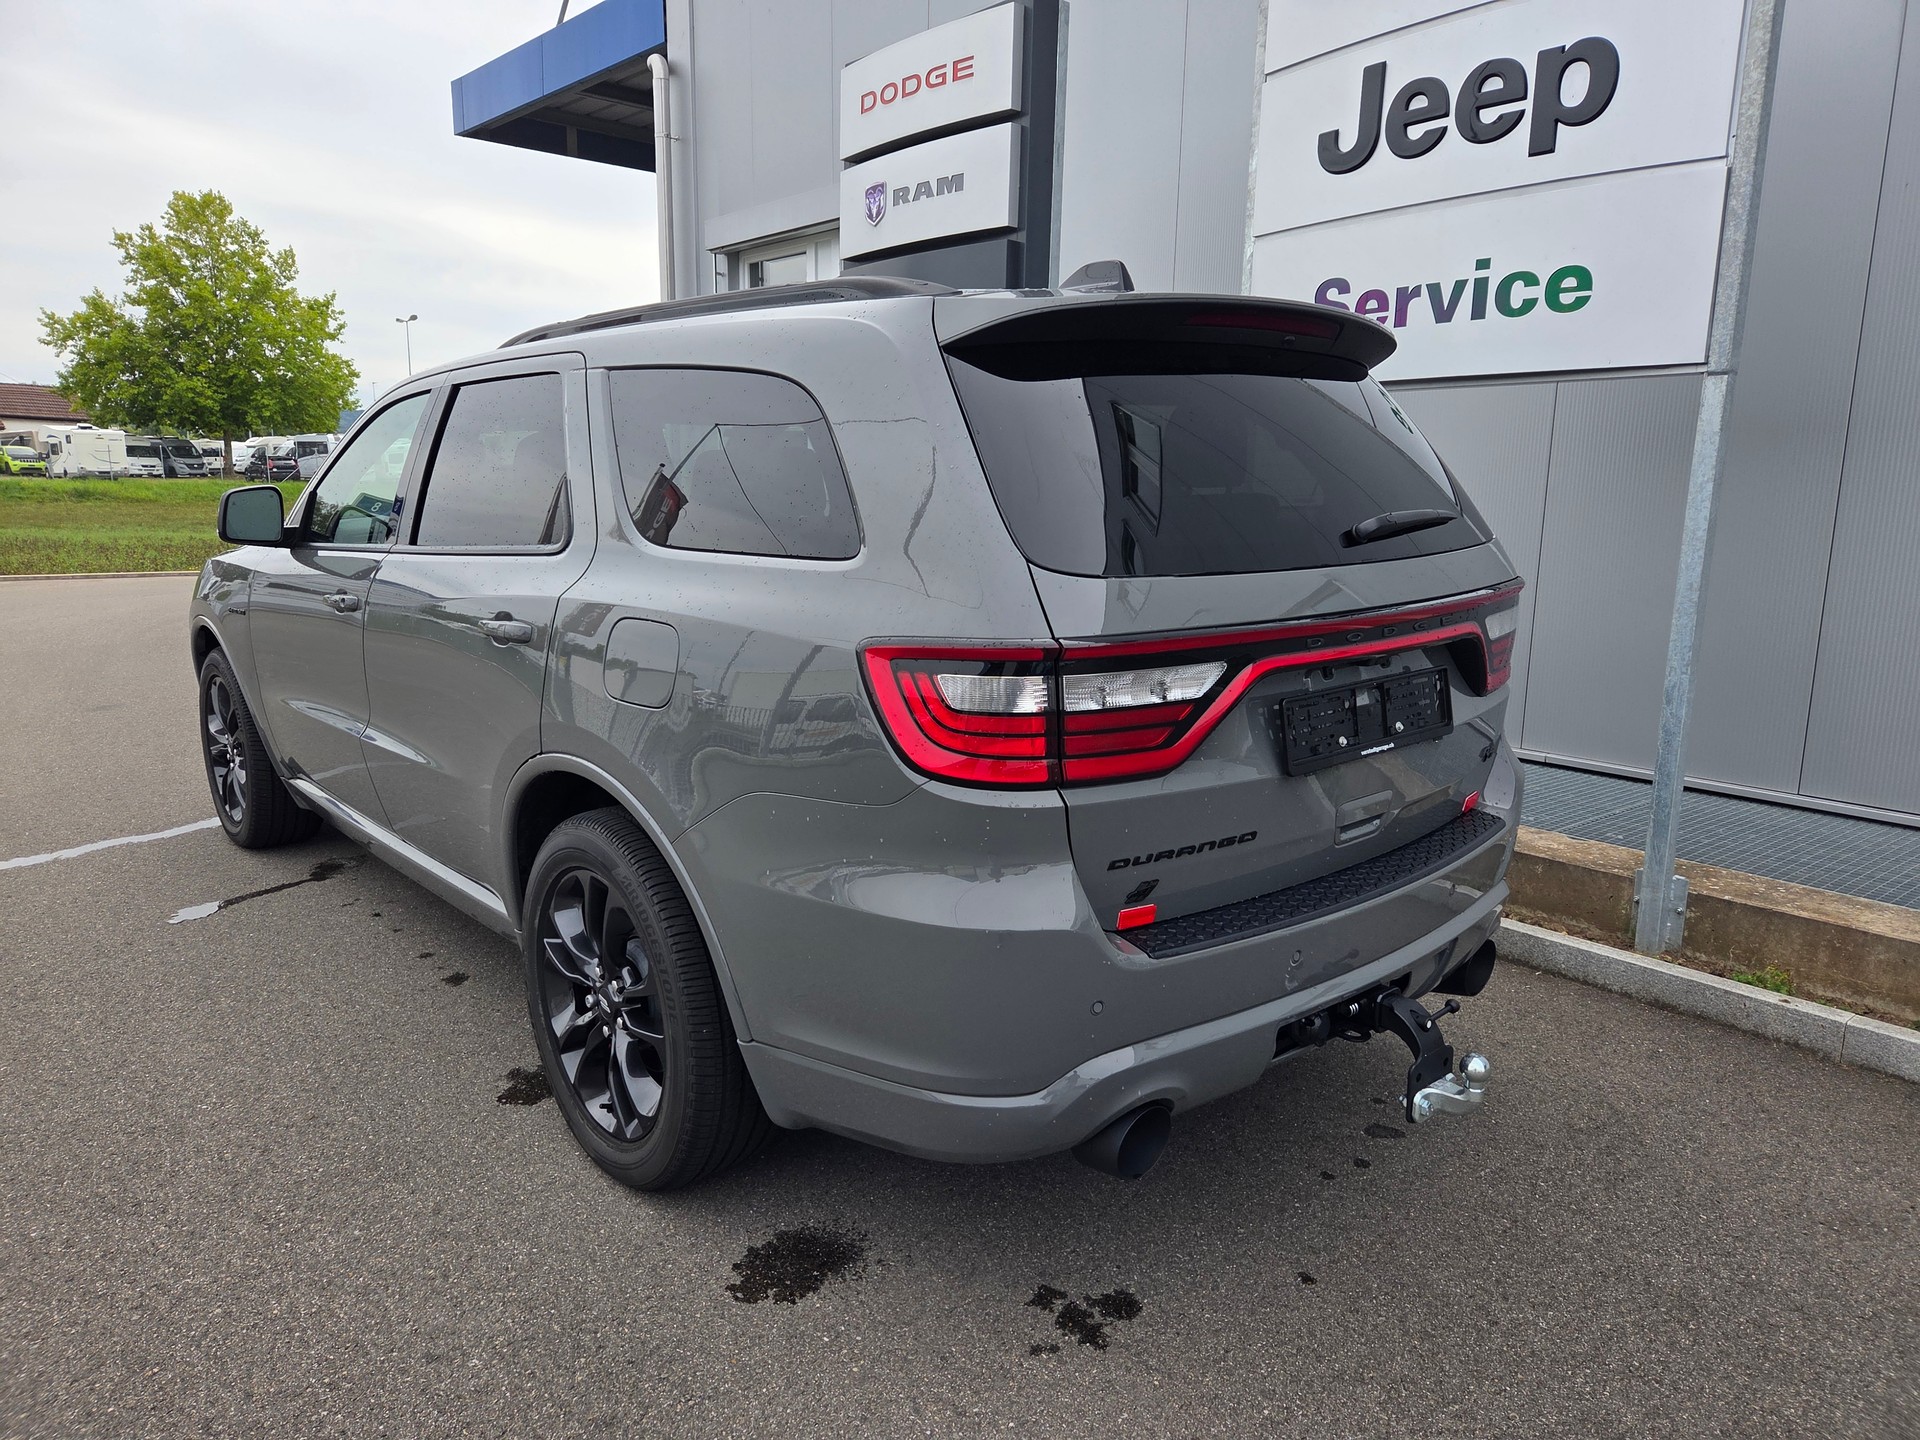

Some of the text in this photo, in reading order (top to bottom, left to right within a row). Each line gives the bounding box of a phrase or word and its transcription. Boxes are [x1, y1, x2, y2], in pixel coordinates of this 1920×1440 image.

[860, 55, 975, 115] DODGE
[1317, 36, 1620, 175] Jeep
[892, 172, 965, 208] RAM
[1314, 257, 1594, 328] Service
[1304, 615, 1455, 649] DODGE
[1106, 830, 1258, 872] DURANGO
